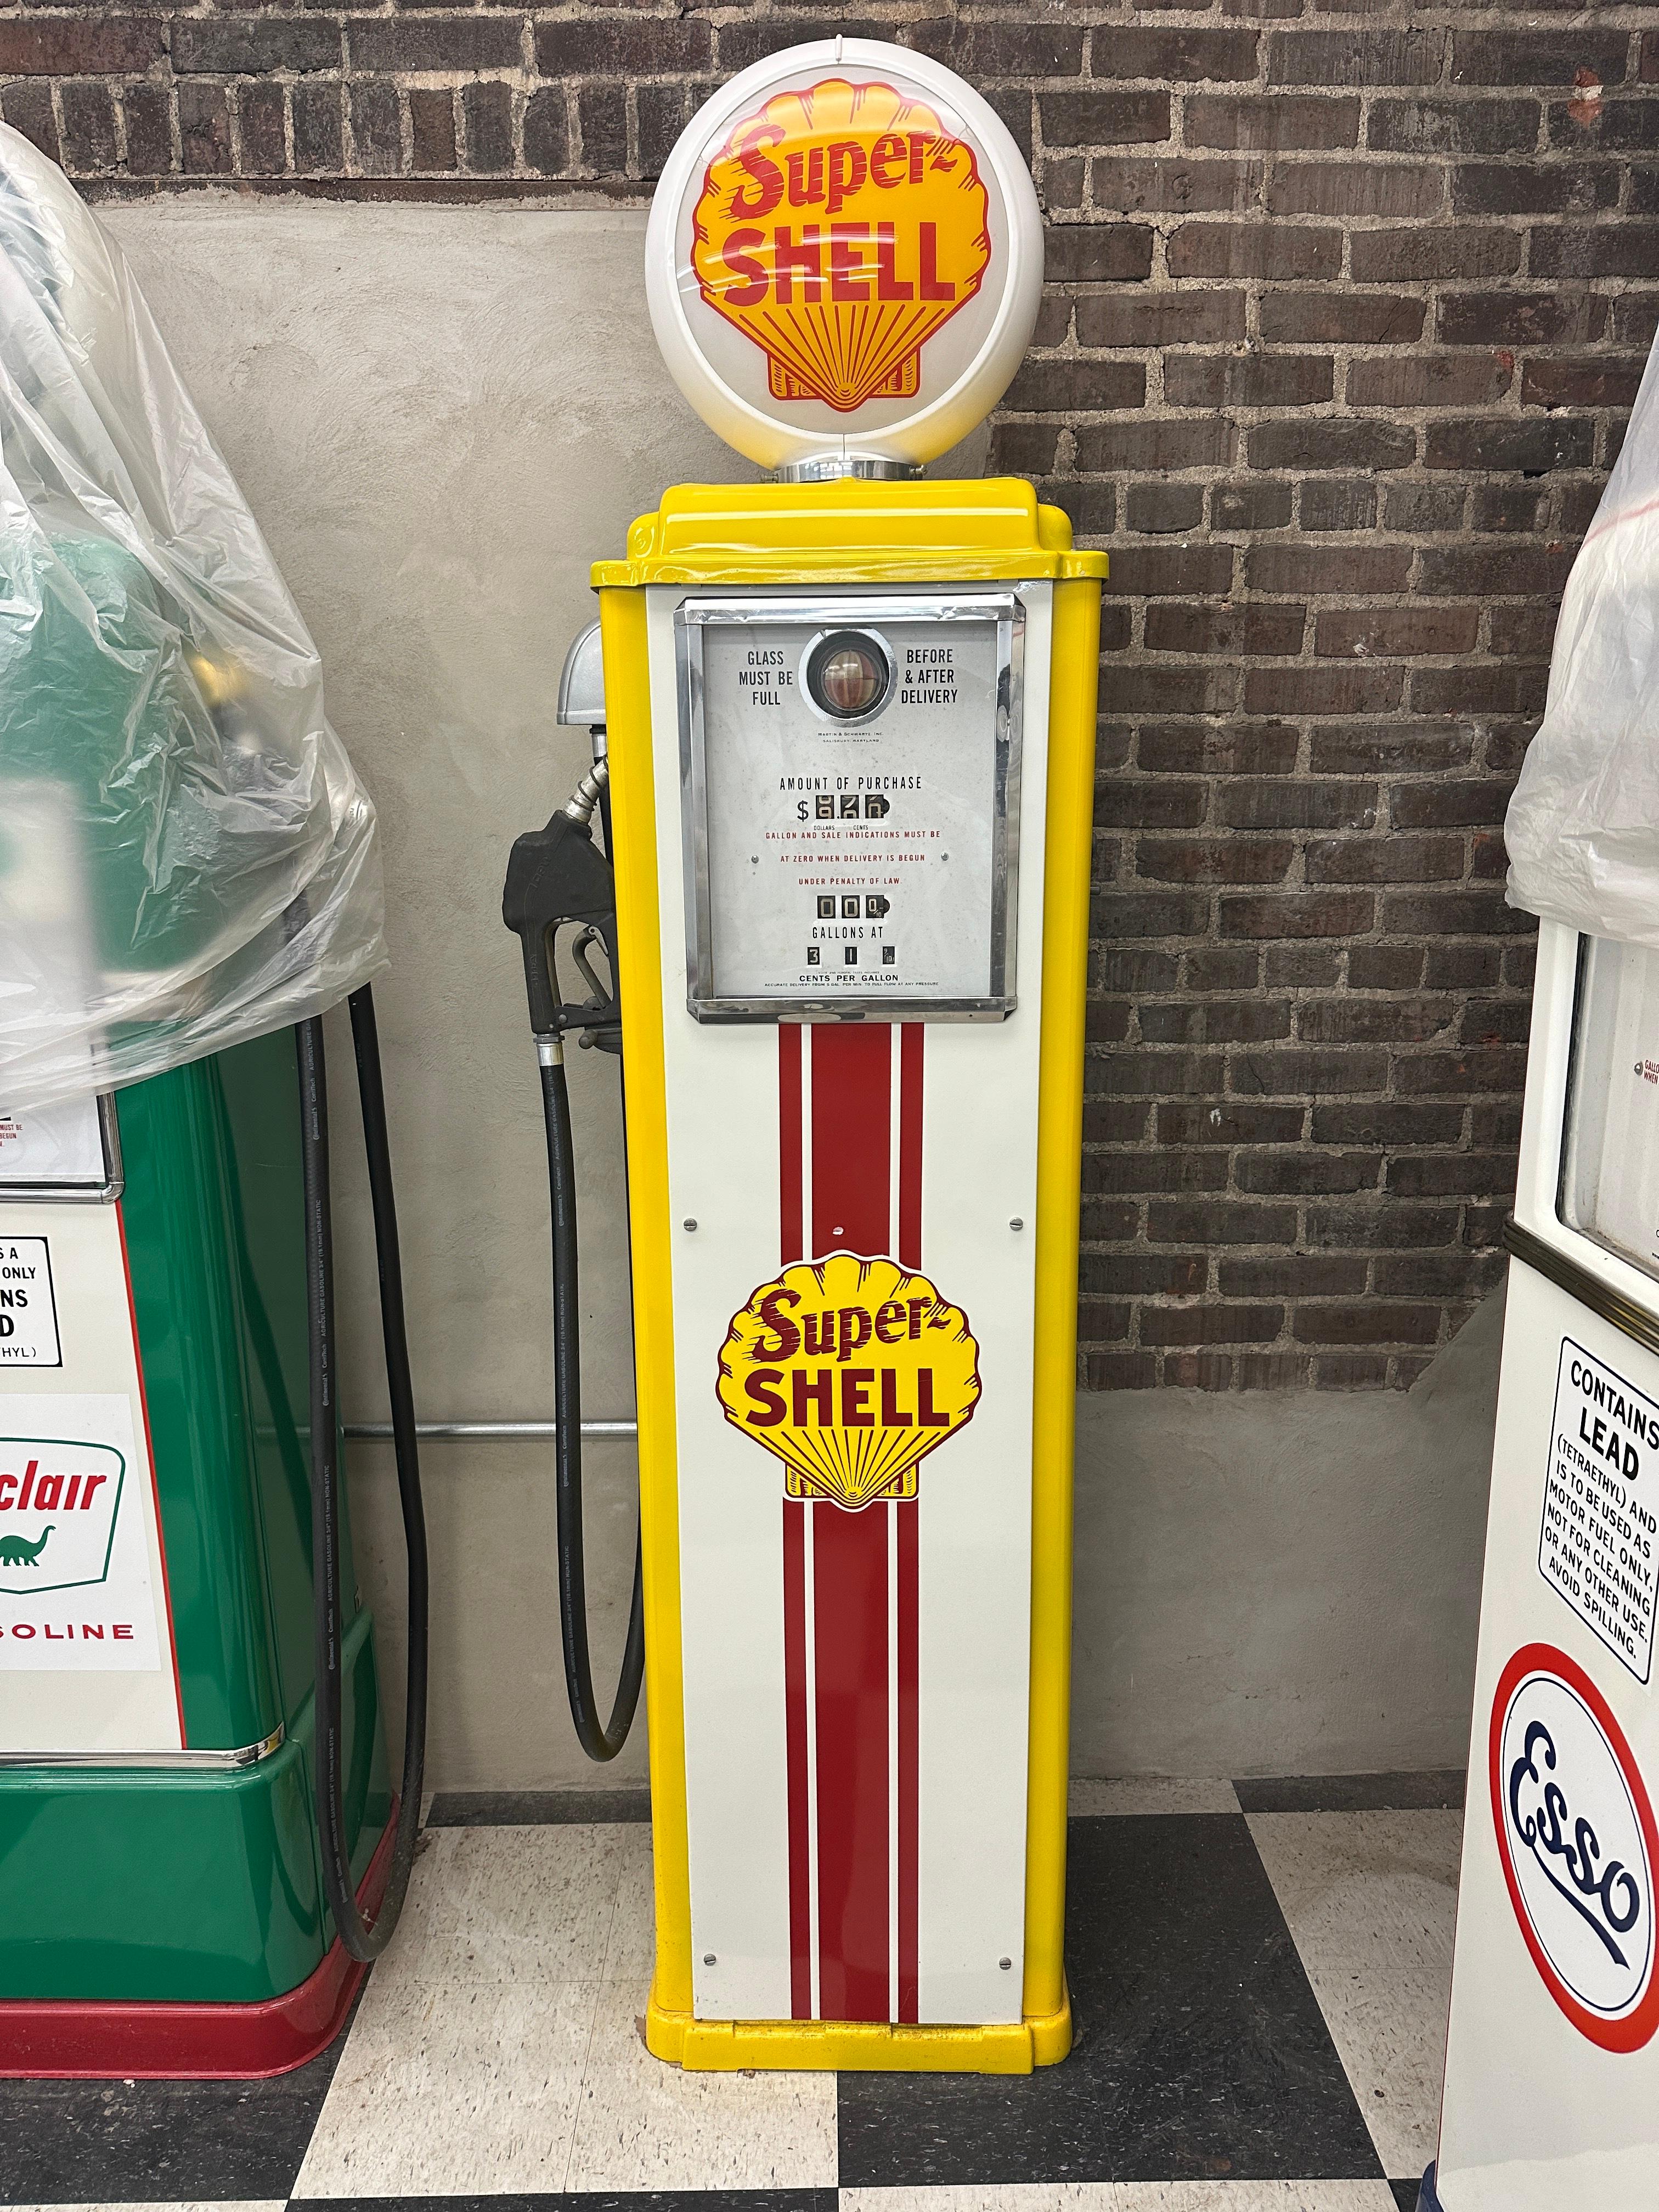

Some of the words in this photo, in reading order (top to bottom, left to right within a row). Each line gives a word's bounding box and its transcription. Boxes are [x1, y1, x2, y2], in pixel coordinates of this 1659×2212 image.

[722, 222, 955, 306] SHELL
[748, 651, 784, 665] GLASS
[907, 649, 953, 663] BEFORE
[739, 672, 770, 685] MUST
[778, 672, 793, 685] BE
[905, 669, 913, 684] &
[918, 669, 954, 684] AFTER
[753, 692, 780, 706] FULL
[901, 689, 958, 703] DELIVERY
[780, 777, 827, 791] AMOUNT
[837, 777, 849, 790] OF
[859, 776, 922, 789] PURCHASE
[812, 926, 864, 939] GALLONS
[871, 926, 883, 939] AT
[809, 949, 819, 963] 3
[1644, 1070, 1658, 1085] WHEN
[10, 1247, 18, 1259] A
[2, 1267, 36, 1279] ONLY
[744, 1368, 950, 1427] SHELL
[1571, 1360, 1659, 1450] CONTAINS
[1579, 1407, 1639, 1481] LEAD
[1558, 1434, 1626, 1508] (TETRAETHYL)
[1629, 1500, 1656, 1533] AND
[1557, 1460, 1566, 1480] IS
[1571, 1472, 1583, 1495] TO
[1586, 1487, 1600, 1511] BE
[1602, 1502, 1632, 1539] USED
[1633, 1533, 1650, 1559] AS
[1550, 1479, 1585, 1525] MOTOR
[1589, 1517, 1615, 1554] FUEL
[1620, 1547, 1652, 1592] ONLY,
[1548, 1502, 1567, 1532] NOT
[1570, 1524, 1590, 1556] FOR
[1594, 1549, 1650, 1617] CLEANING
[1545, 1526, 1558, 1550] OR
[1561, 1544, 1582, 1573] ANY
[1585, 1567, 1619, 1612] OTHER
[1623, 1604, 1647, 1643] USE.
[1549, 1556, 1580, 1596] AVOID
[1584, 1592, 1636, 1658] SPILLING.
[0, 1624, 133, 1639] OLINE
[1510, 1720, 1640, 1970] Esso
